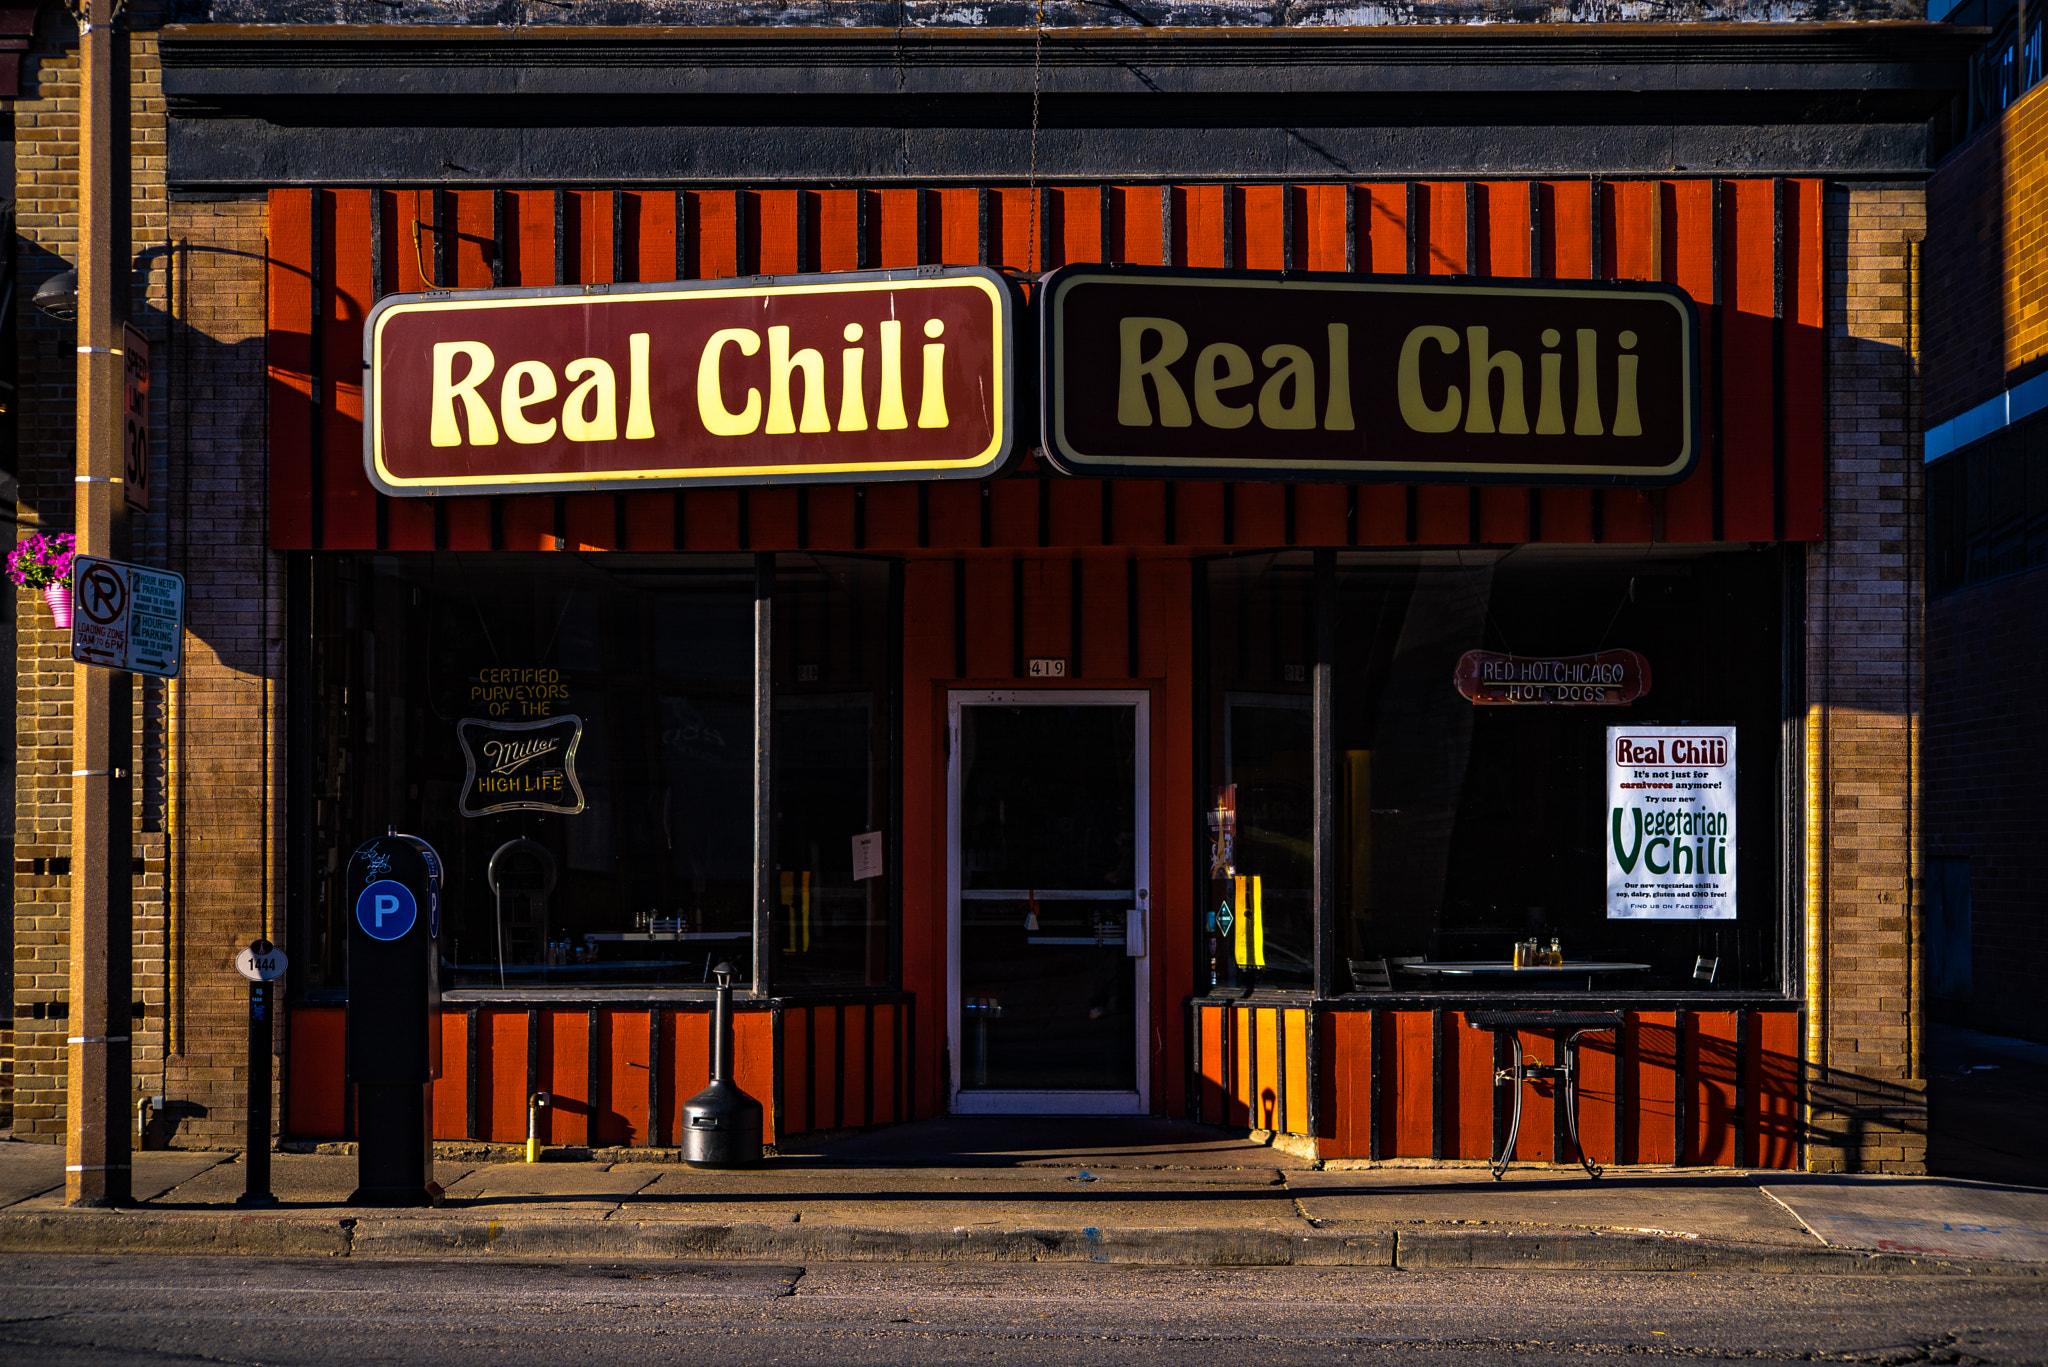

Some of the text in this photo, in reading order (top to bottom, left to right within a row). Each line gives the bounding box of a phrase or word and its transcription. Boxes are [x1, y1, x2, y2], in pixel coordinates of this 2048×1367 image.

[127, 347, 147, 382] SPEED
[430, 318, 949, 448] Real Chili
[1117, 316, 1643, 436] Real Chili
[129, 384, 145, 417] LIMIT
[127, 419, 147, 490] 30
[133, 573, 177, 592] 2 HOUR METER
[142, 585, 170, 598] PARKING
[77, 622, 124, 640] LOADING ZONE
[132, 615, 140, 637] 2
[142, 616, 162, 628] HOUR
[78, 633, 95, 645] 7AM
[96, 637, 105, 645] TO
[105, 638, 123, 651] 6PM
[142, 628, 172, 643] PARKING
[479, 668, 560, 684] CERTIFIED
[1031, 661, 1064, 675] 419
[1484, 662, 1624, 684] RED HOT CHICAGO
[471, 684, 569, 701] PURVEYORS
[1510, 685, 1605, 701] HOT DOGS
[489, 701, 551, 716] OF THE
[483, 737, 560, 768] Miller
[1619, 739, 1725, 764] Real Chili
[478, 775, 563, 792] HIGH LIFE
[1671, 771, 1691, 780] just
[1620, 781, 1722, 790] carnivores anymore!
[1612, 805, 1727, 875] Vegetarian
[1644, 837, 1727, 875] Chili
[1656, 882, 1693, 890] vegetarian
[375, 894, 400, 927] P
[249, 958, 275, 970] 1444
